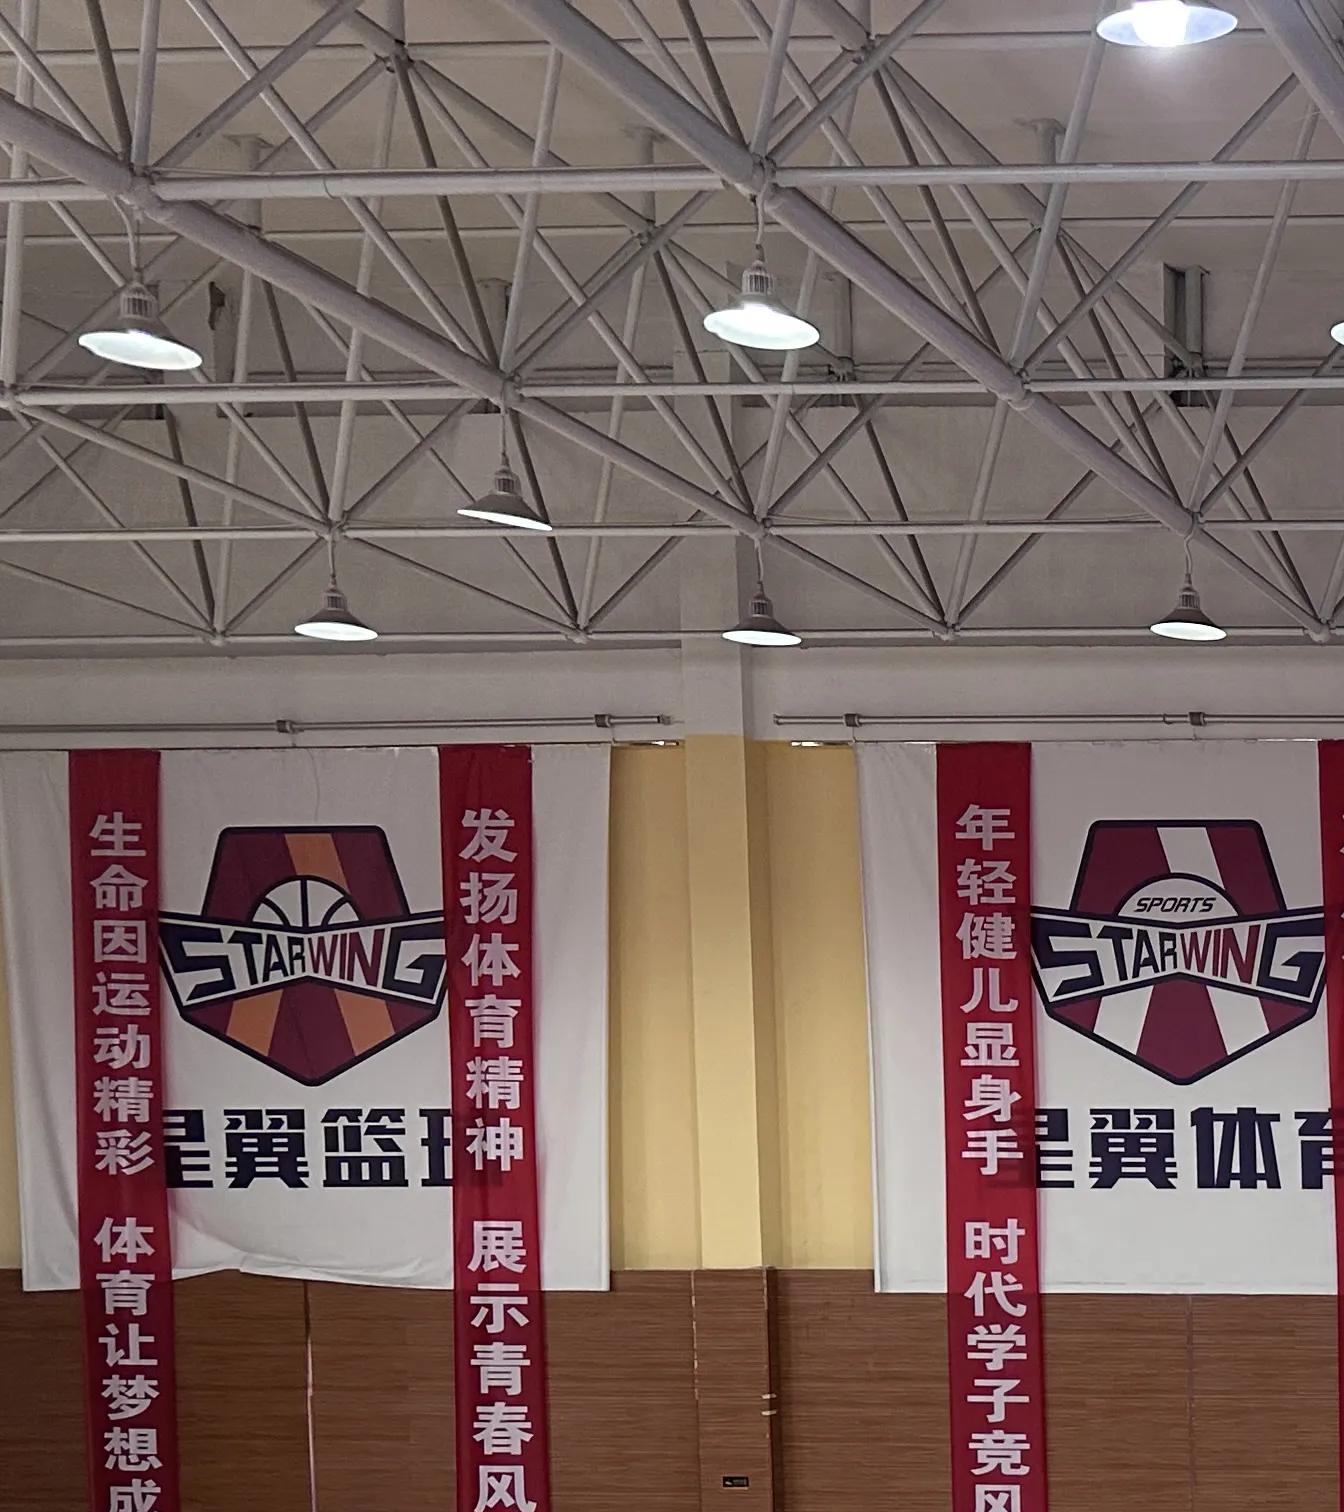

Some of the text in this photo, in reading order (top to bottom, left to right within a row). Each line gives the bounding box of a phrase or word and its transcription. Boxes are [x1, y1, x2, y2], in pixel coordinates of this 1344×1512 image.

[90, 812, 153, 1175] 生命因运动精彩
[161, 921, 447, 1001] STARWING
[459, 808, 524, 1171] 发扬体育精神
[955, 804, 1023, 1175] 年轻健儿显身手
[1033, 918, 1325, 998] STARWING
[1134, 897, 1216, 912] SPORTS
